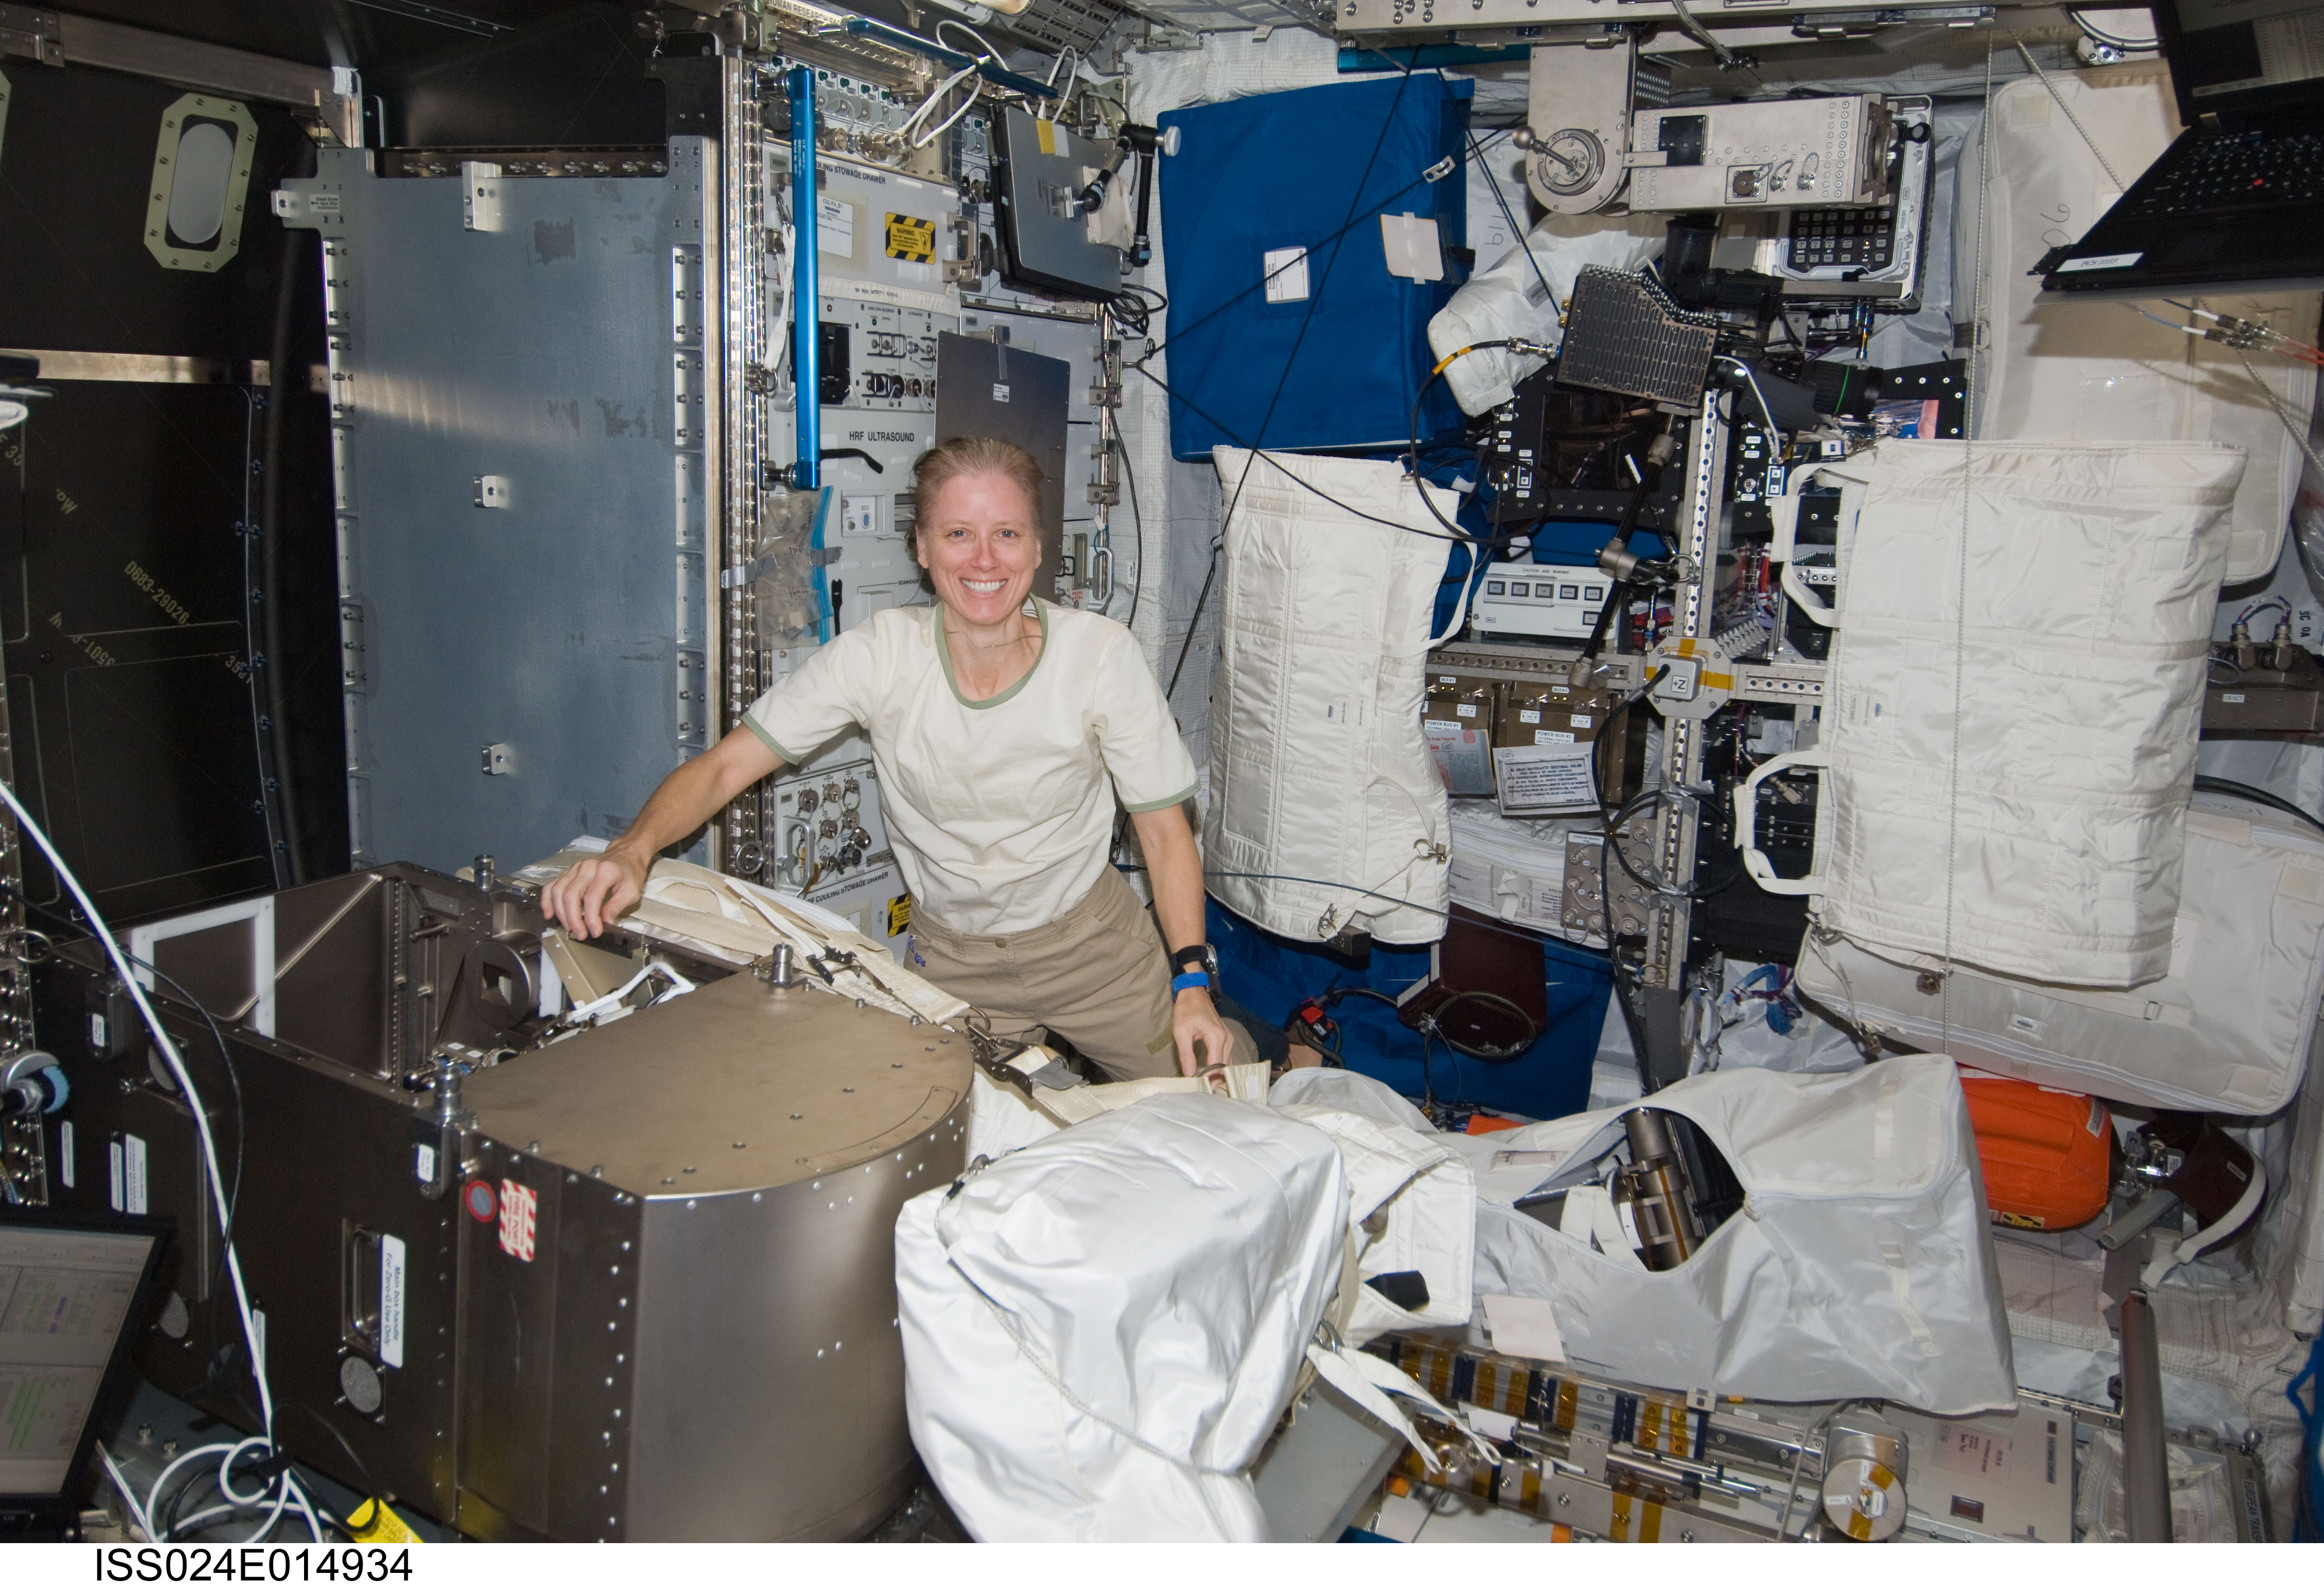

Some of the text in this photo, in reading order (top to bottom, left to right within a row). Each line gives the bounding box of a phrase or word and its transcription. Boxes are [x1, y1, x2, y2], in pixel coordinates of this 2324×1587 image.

[793, 4, 828, 22] RESEARCH
[816, 163, 886, 185] OLING STOWAGE DRAWER
[897, 227, 915, 237] WARNING
[849, 431, 914, 442] HRF ULTRASOUND
[2299, 611, 2310, 621] SC
[1674, 679, 1686, 690] +Z
[816, 890, 840, 904] COOLING
[841, 879, 867, 895] STOWAGE
[867, 871, 888, 885] DRAWER
[2244, 1481, 2259, 1514] EUROPEAN
